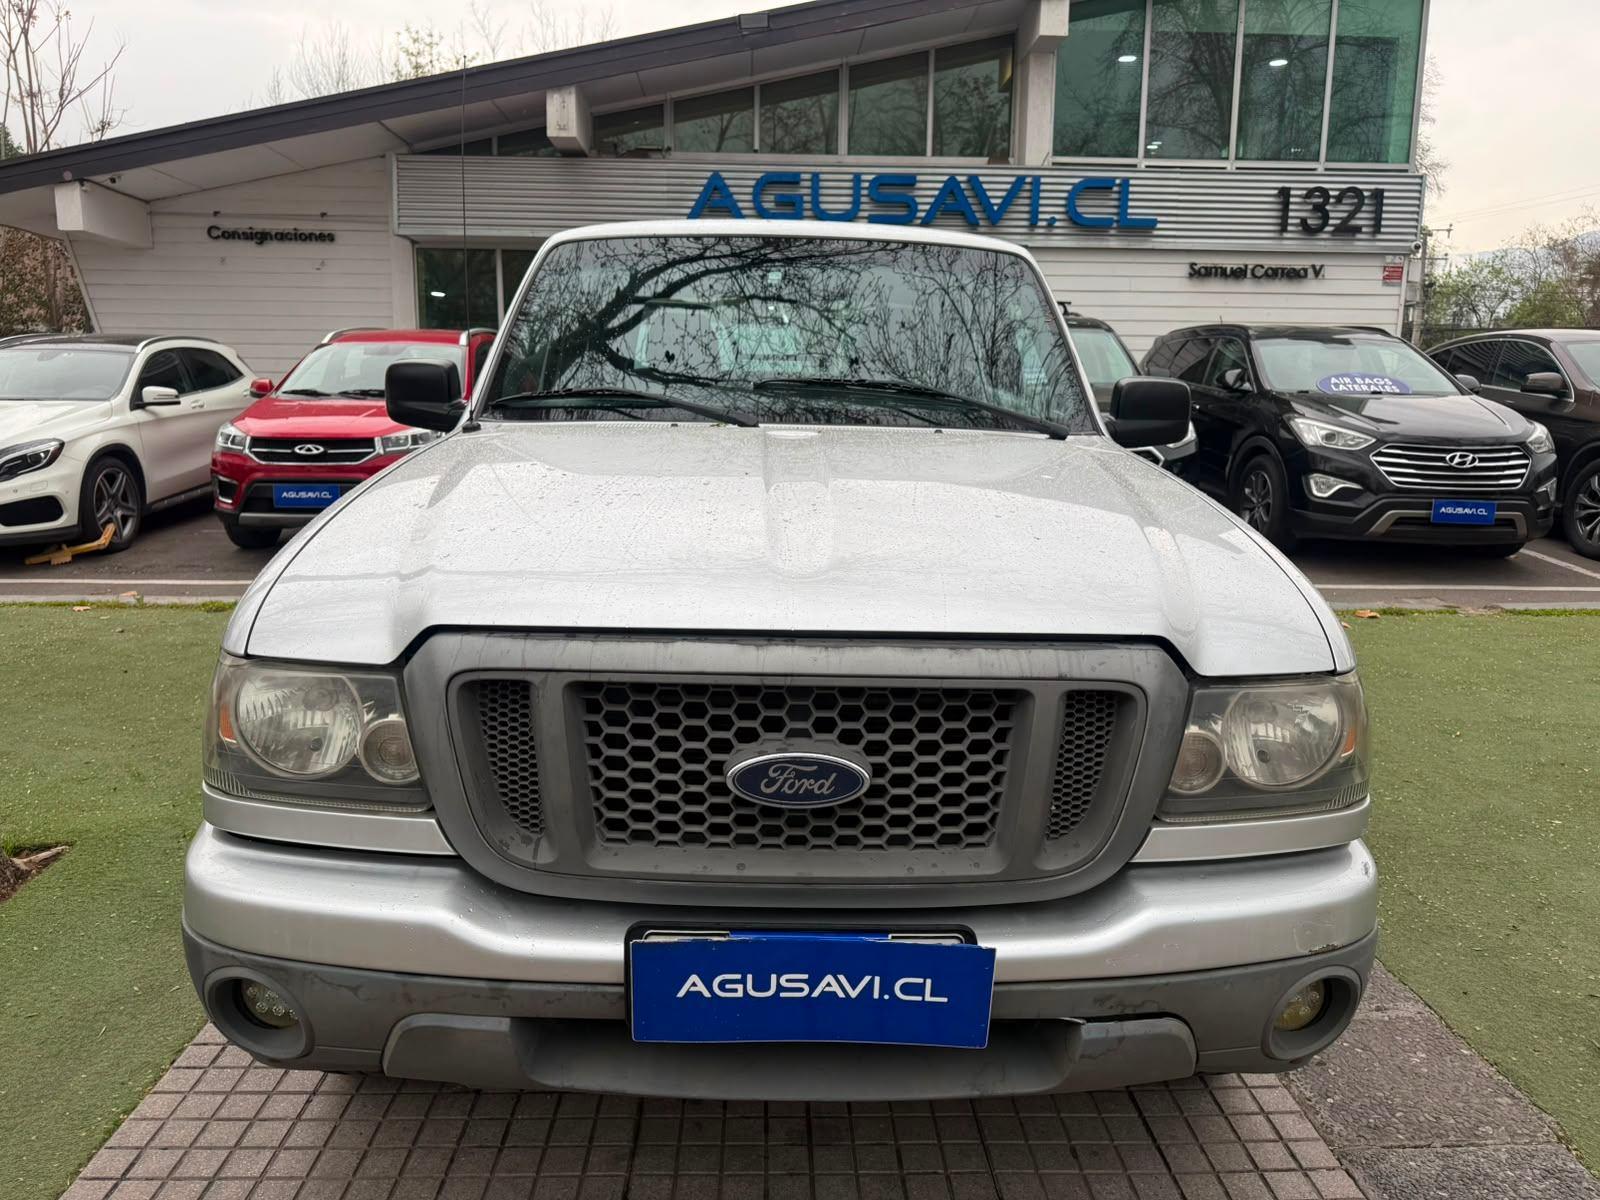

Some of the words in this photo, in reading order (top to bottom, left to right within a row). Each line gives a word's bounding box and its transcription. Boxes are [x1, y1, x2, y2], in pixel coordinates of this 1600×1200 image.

[686, 170, 1158, 229] AGUSAVI.CL
[1276, 186, 1385, 235] 1321
[207, 225, 335, 245] Consignaciones
[1188, 262, 1248, 279] Samuel
[1250, 264, 1308, 279] Correa
[1330, 376, 1353, 385] AIR
[1354, 377, 1393, 386] BAGS
[1330, 384, 1400, 393] LATERALES
[760, 763, 838, 795] Ford
[676, 973, 949, 1003] AGUSAVI.CL
